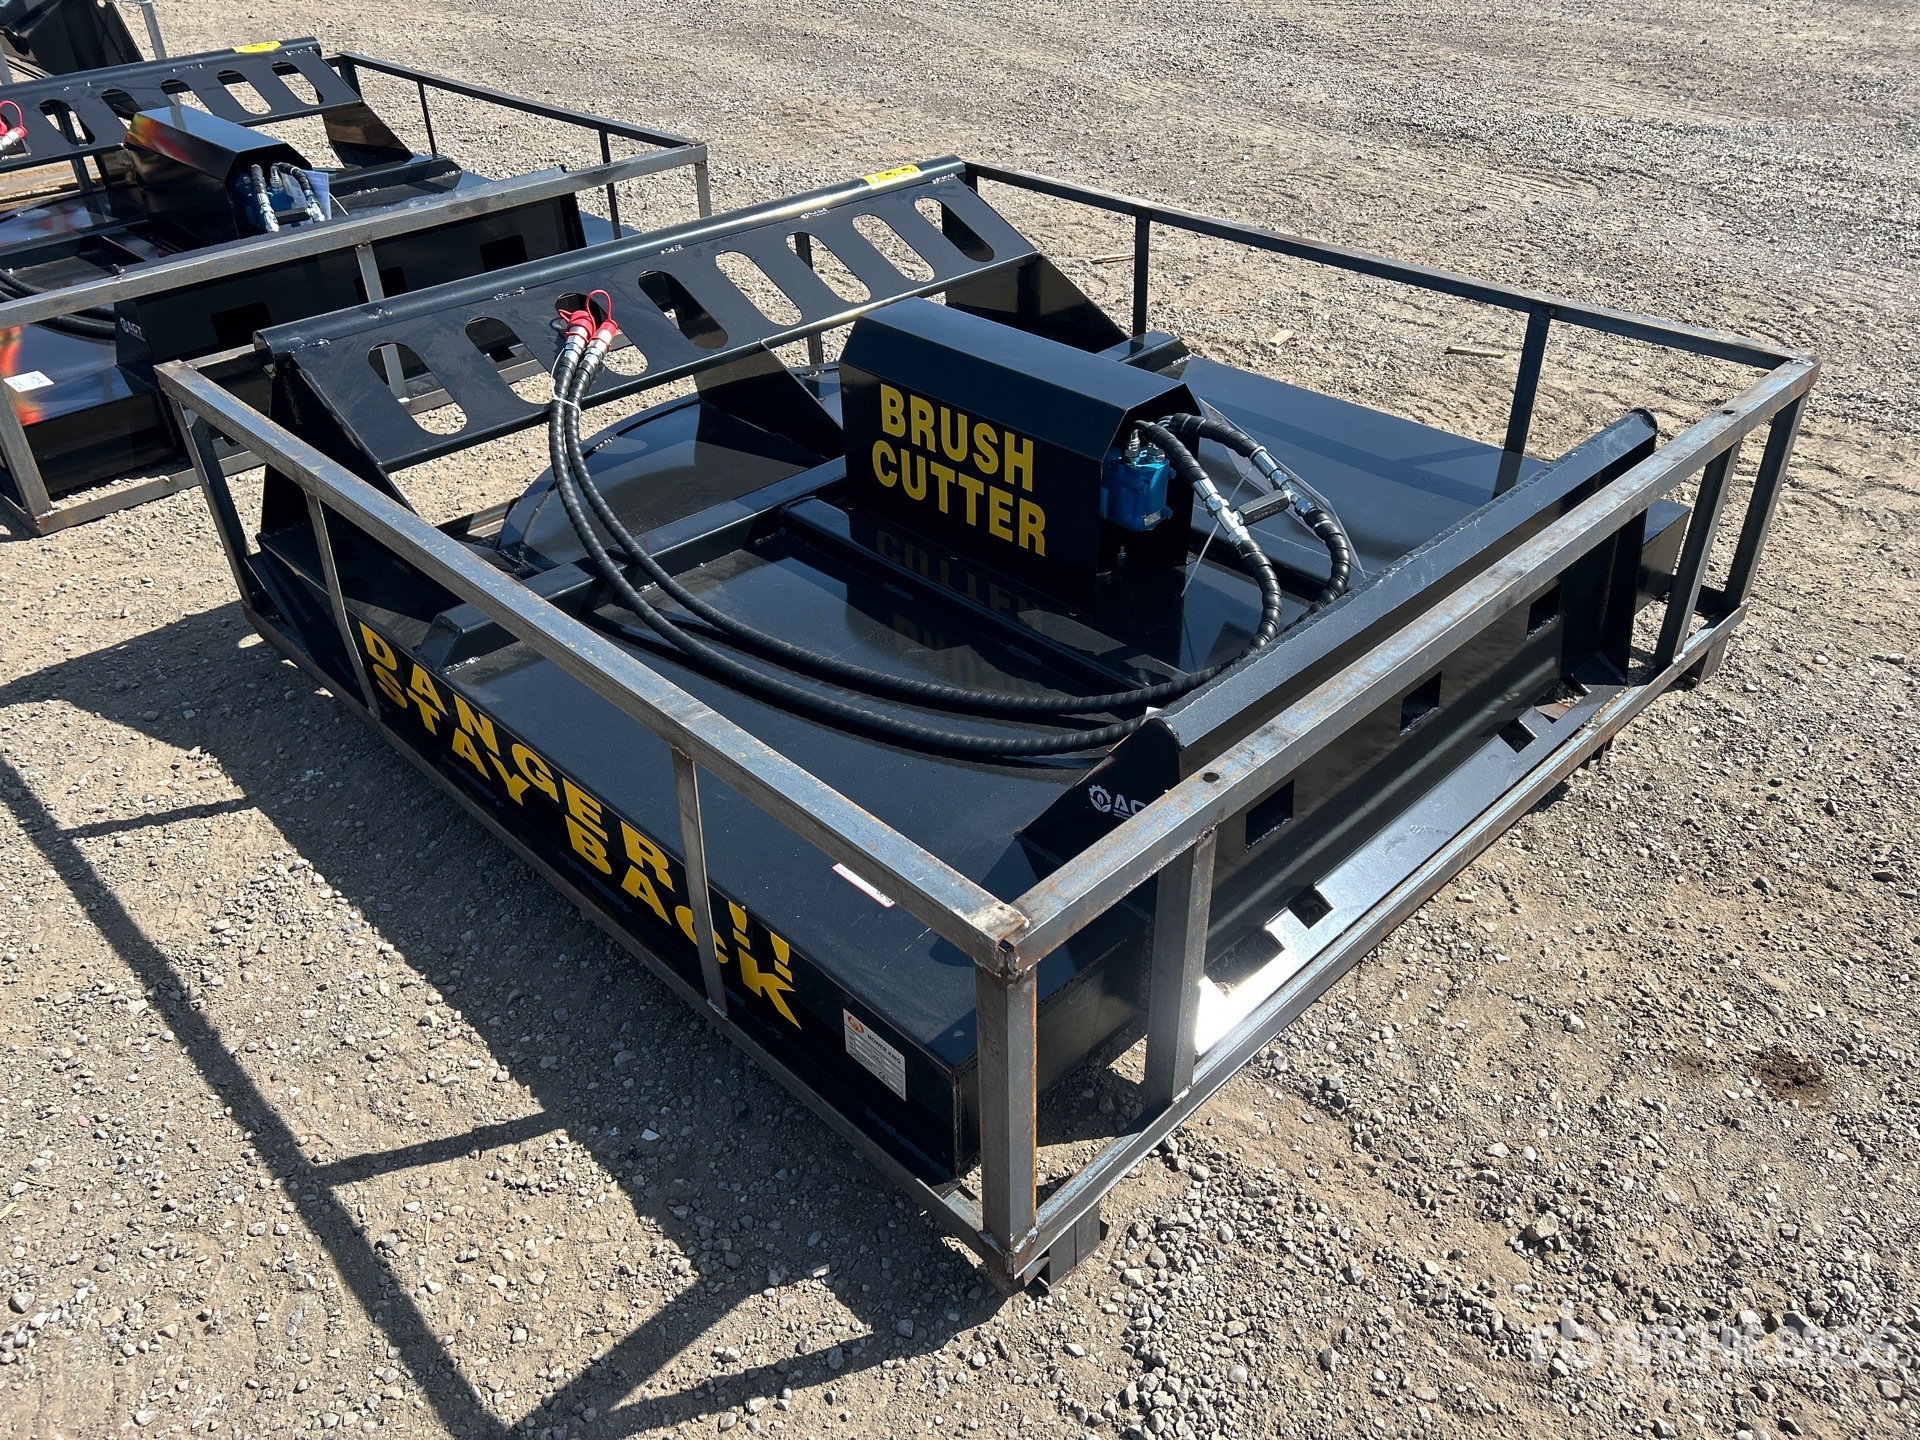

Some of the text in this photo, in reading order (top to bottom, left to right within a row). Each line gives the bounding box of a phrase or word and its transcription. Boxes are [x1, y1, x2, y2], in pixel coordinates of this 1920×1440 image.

[881, 383, 1034, 492] BRUSH
[872, 440, 1046, 557] CUTTER
[372, 663, 802, 1030] STAY BACK
[887, 1050, 902, 1064] KING
